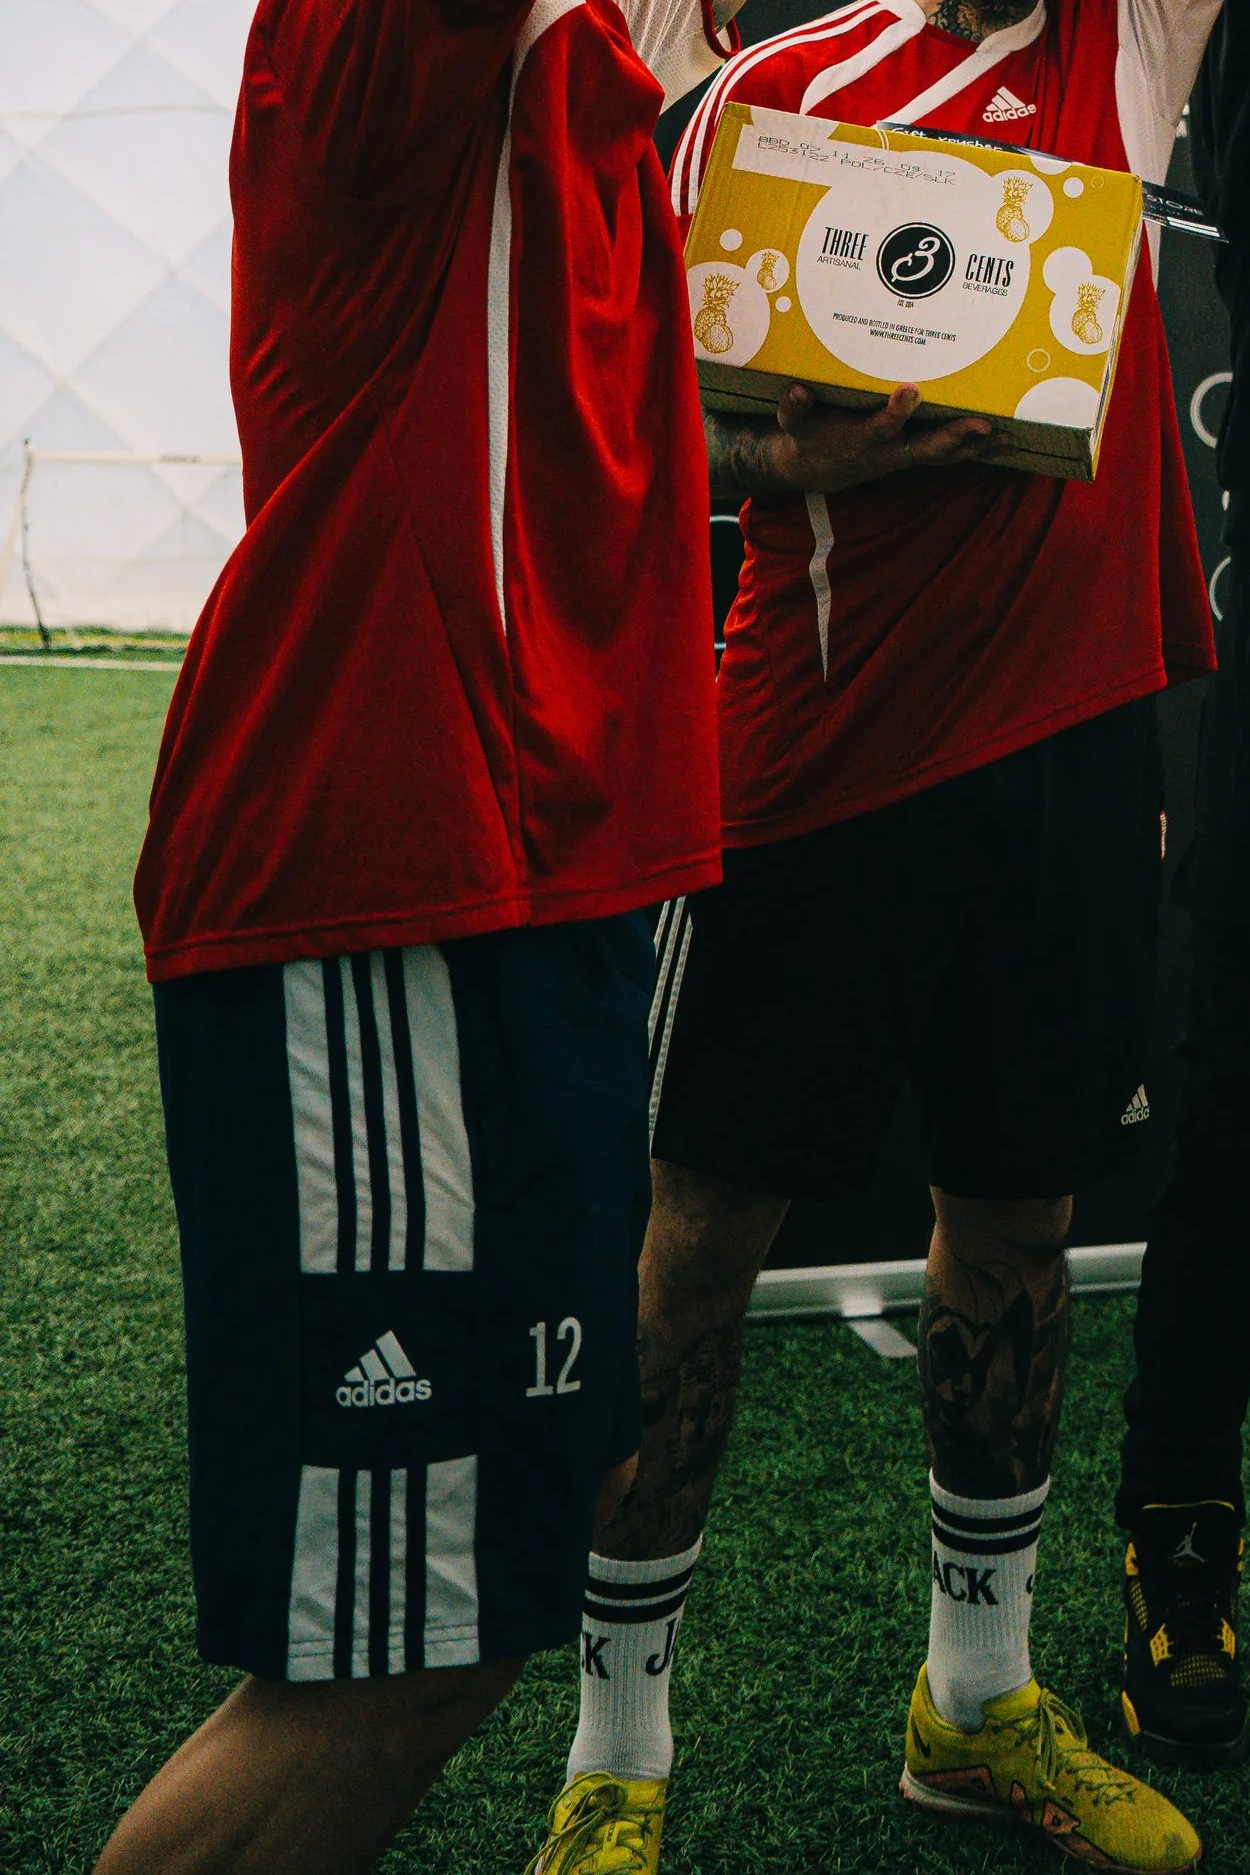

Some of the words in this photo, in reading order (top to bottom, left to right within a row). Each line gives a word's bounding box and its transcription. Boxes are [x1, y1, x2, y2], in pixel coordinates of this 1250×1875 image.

[982, 104, 1037, 123] adidas
[822, 226, 870, 261] THREE
[965, 253, 1015, 288] CENTS
[817, 255, 862, 271] ARTISANAL
[962, 283, 1009, 297] BEVERAGES
[833, 312, 858, 324] PRODUCED
[858, 317, 869, 325] AND
[896, 324, 914, 334] GREECE
[914, 328, 924, 336] FOR
[925, 329, 941, 339] THREE
[941, 333, 957, 342] CENTS
[526, 1316, 582, 1397] 12
[335, 1376, 432, 1407] adidas
